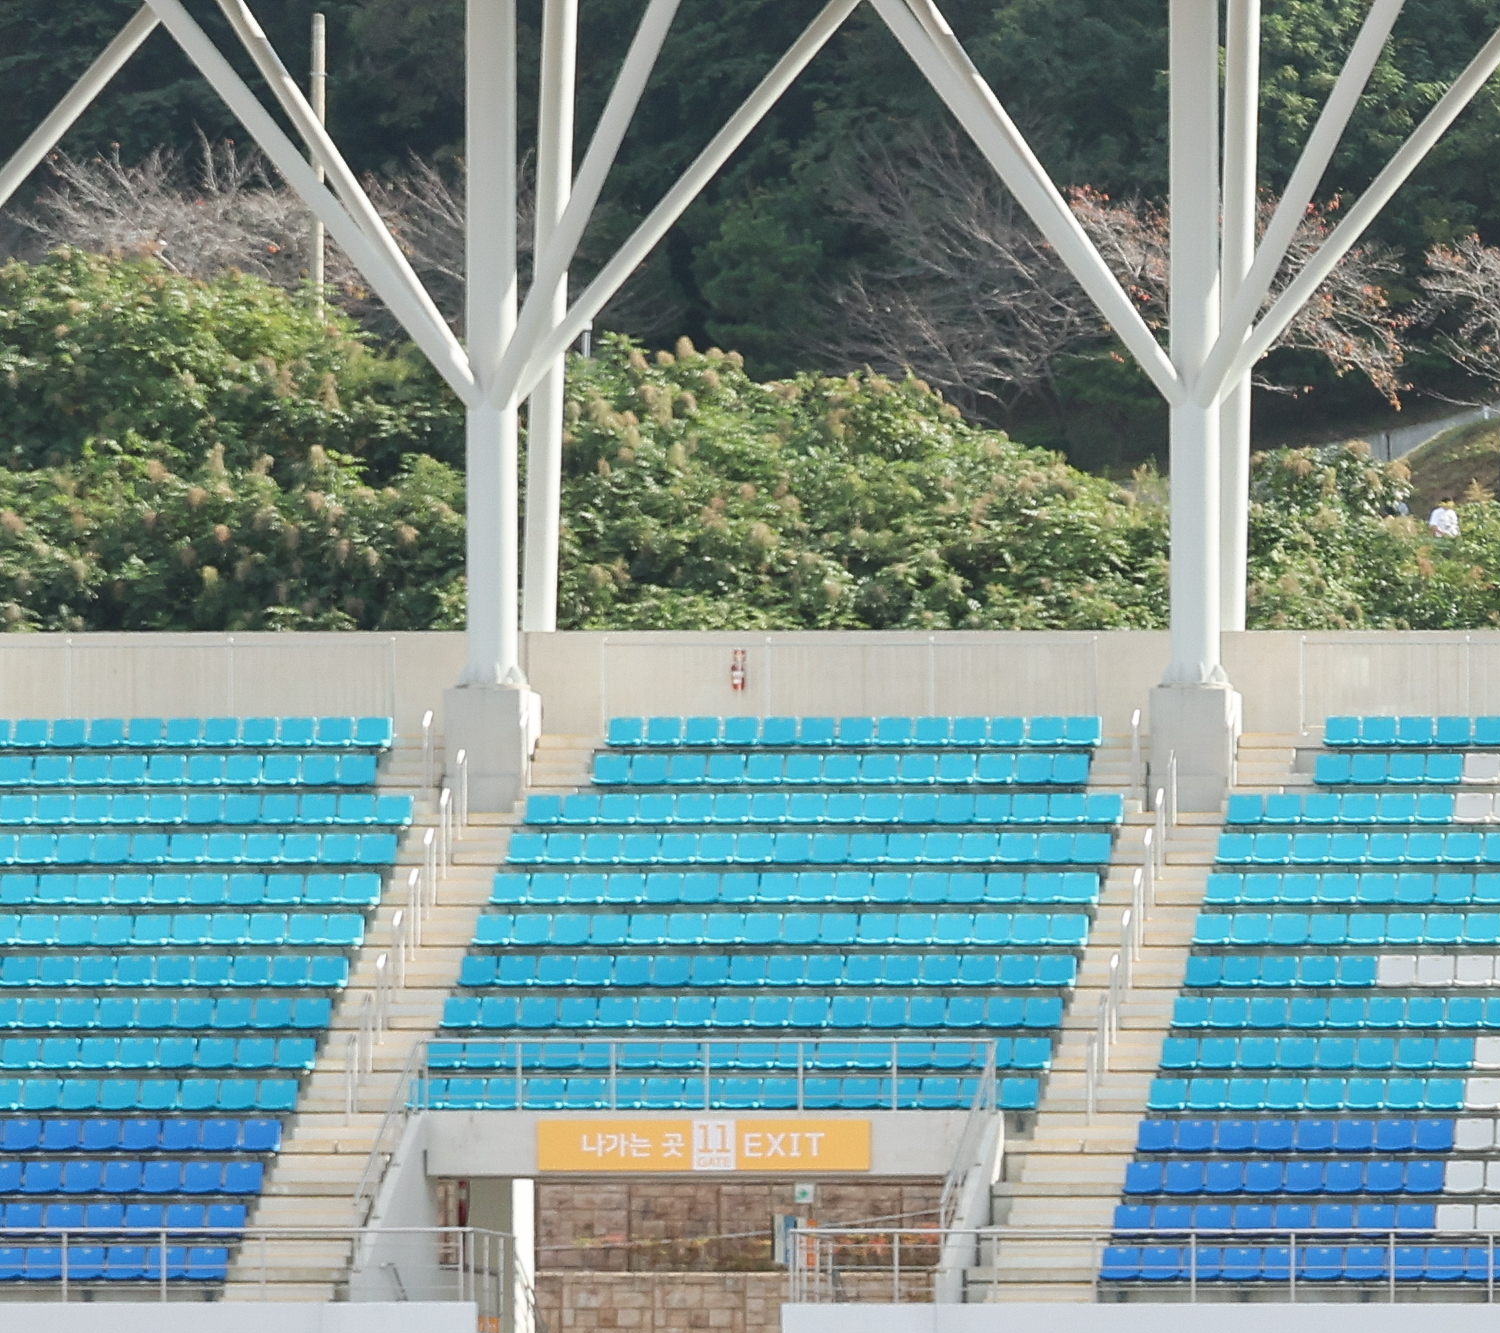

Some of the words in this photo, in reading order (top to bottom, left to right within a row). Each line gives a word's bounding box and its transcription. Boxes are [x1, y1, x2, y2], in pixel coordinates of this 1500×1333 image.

[582, 1133, 653, 1157] 나가는
[661, 1133, 685, 1158] 곳
[698, 1124, 731, 1154] 11
[744, 1132, 825, 1157] EXIT
